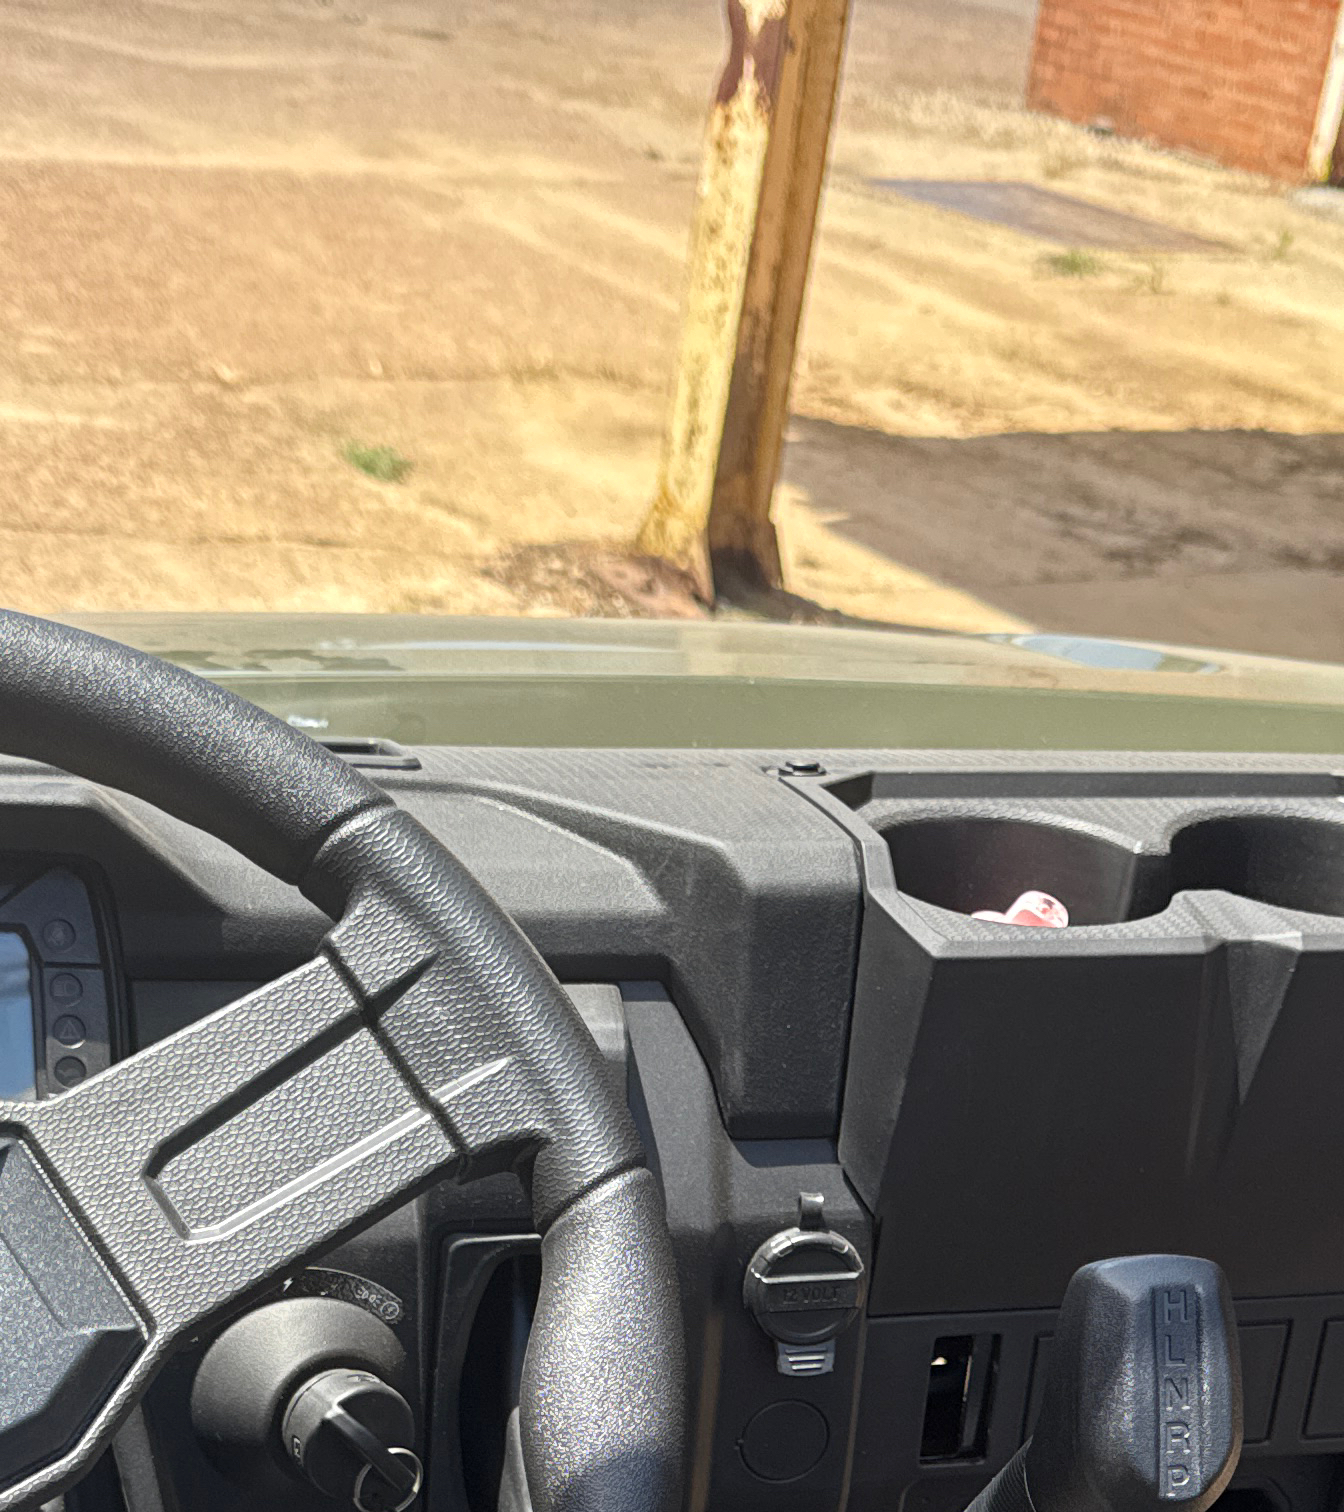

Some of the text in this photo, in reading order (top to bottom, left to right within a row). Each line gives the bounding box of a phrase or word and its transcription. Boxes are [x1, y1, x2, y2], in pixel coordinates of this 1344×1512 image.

[1163, 1290, 1189, 1325] H
[1164, 1334, 1187, 1367] L
[1165, 1377, 1191, 1412] N
[1166, 1421, 1191, 1455] R
[1167, 1464, 1191, 1497] P
